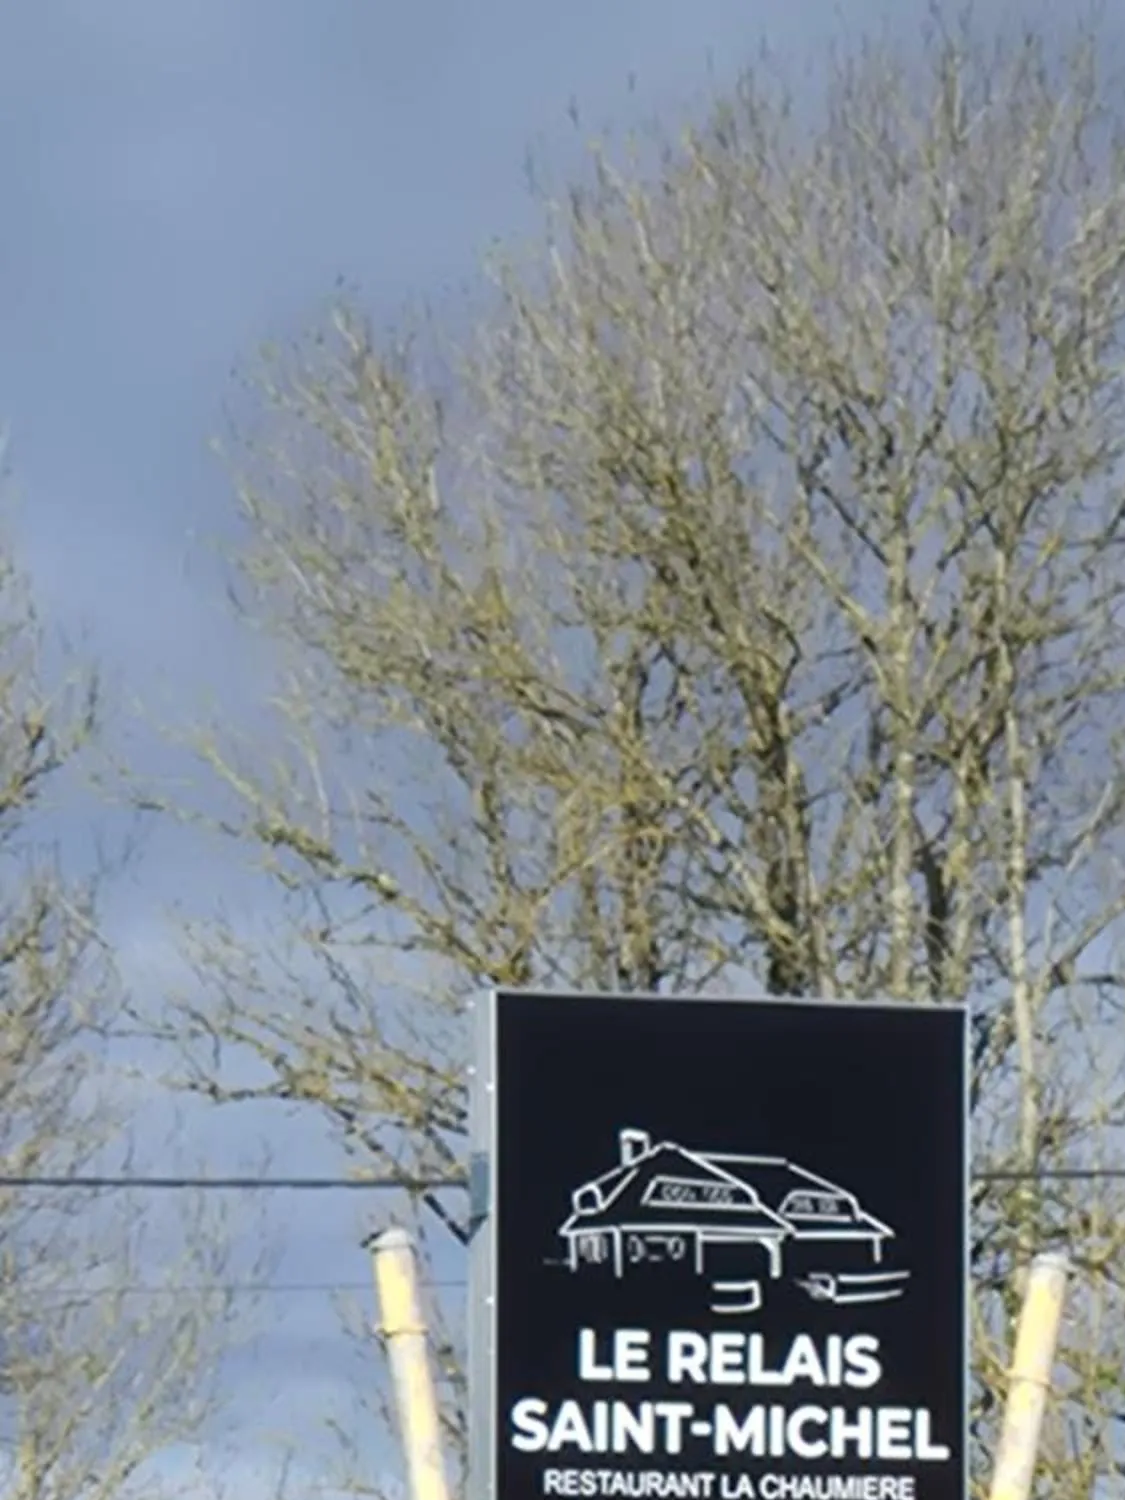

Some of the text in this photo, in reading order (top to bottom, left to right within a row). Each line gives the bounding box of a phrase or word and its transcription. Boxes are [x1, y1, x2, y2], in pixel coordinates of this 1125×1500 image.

[579, 1328, 882, 1388] LE RELAIS
[511, 1398, 950, 1461] SAINT-MICHEL
[543, 1469, 716, 1498] RESTAURANT
[721, 1473, 755, 1500] LA
